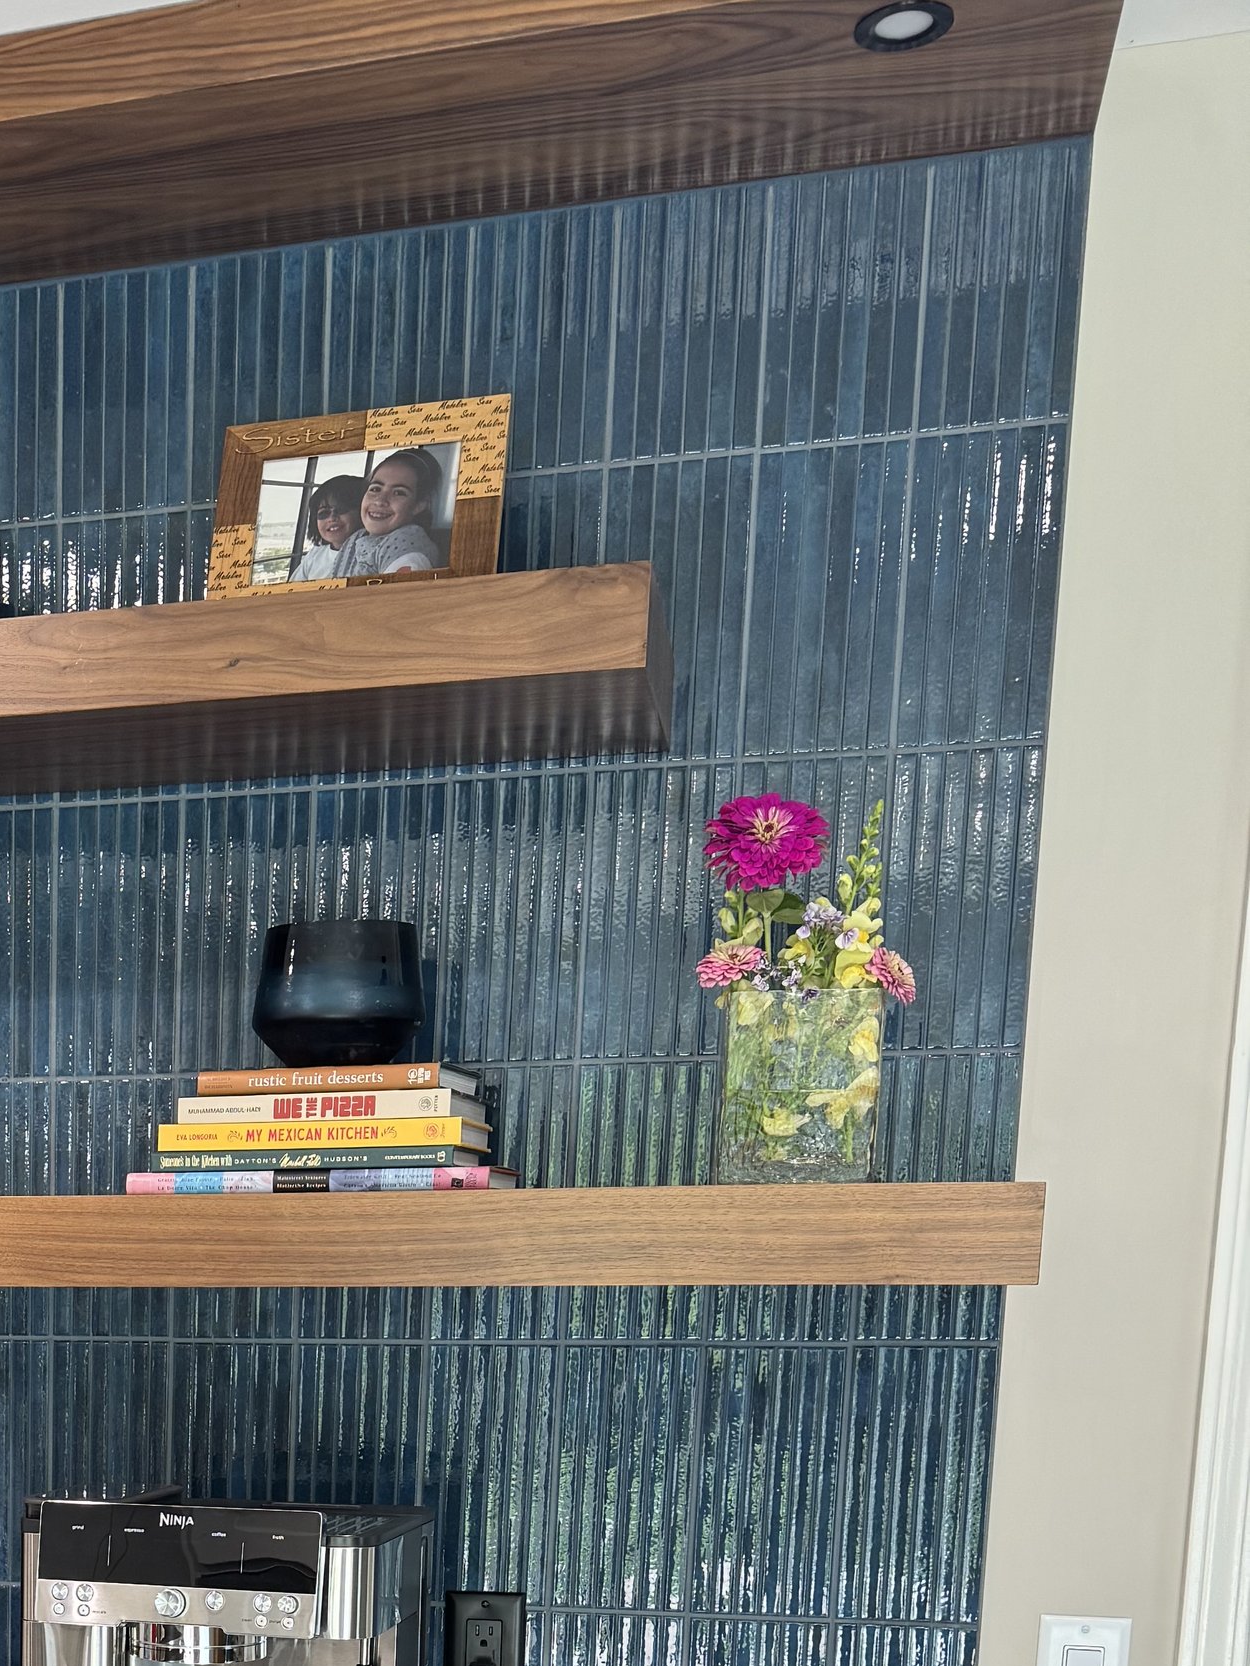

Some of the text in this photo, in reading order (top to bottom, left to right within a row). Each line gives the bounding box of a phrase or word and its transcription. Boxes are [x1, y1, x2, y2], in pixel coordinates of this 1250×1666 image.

[235, 420, 355, 454] Sister
[248, 1070, 384, 1087] rustic fruit desserts
[273, 1096, 376, 1120] WE THE PIZZA
[188, 1133, 218, 1141] LONGORIA
[246, 1126, 378, 1142] MY MEXICAN KITCHEN
[159, 1512, 194, 1530] NINJA
